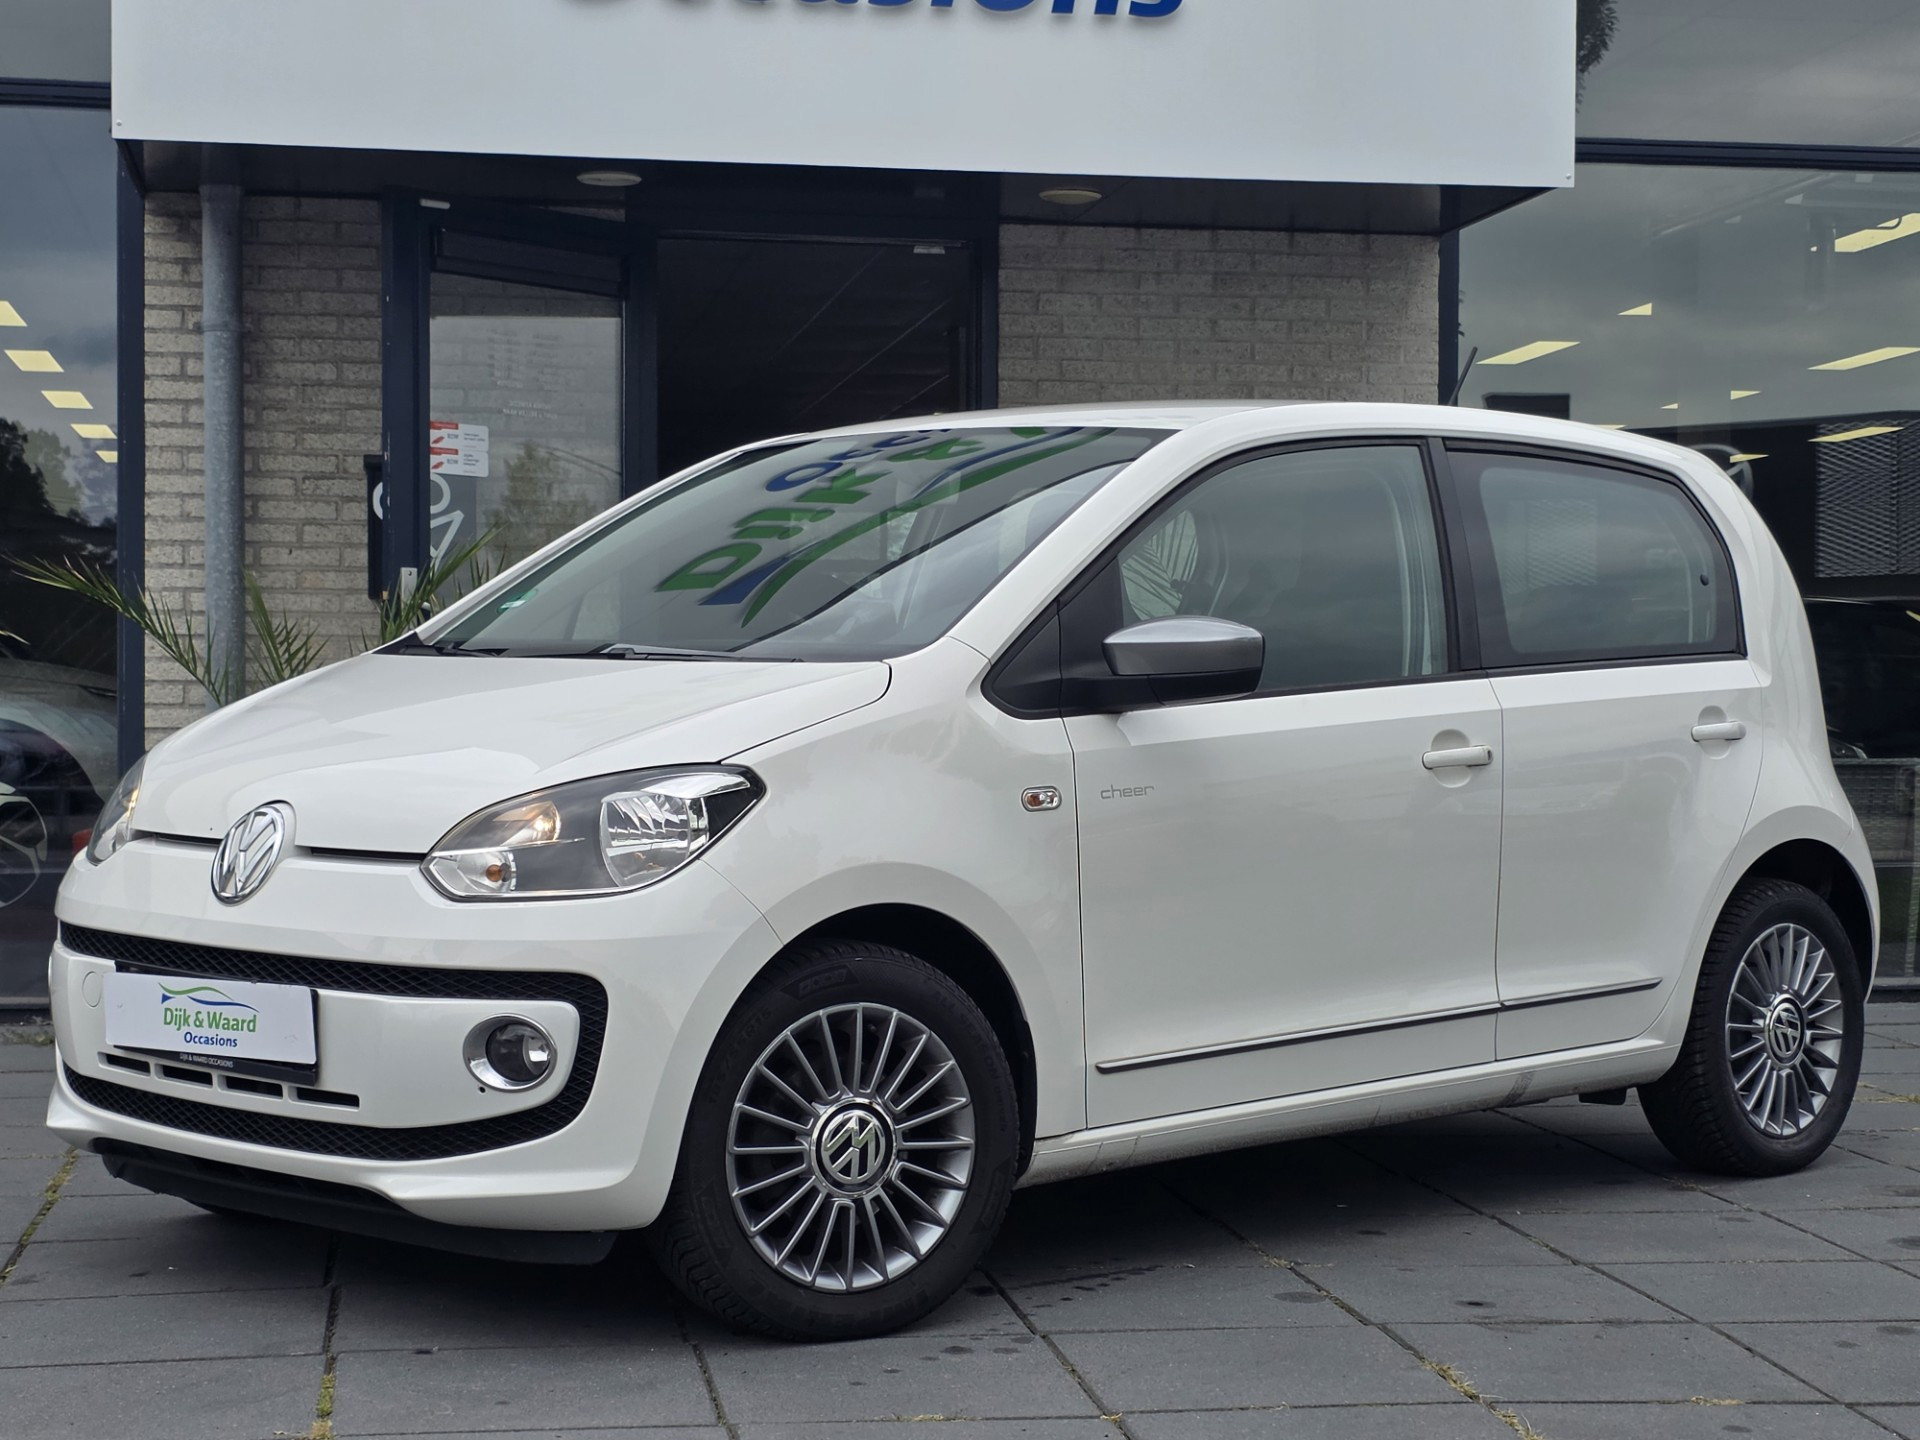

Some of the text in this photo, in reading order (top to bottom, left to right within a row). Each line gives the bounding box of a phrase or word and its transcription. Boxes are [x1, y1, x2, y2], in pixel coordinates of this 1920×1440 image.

[1100, 784, 1155, 800] cheer
[163, 1007, 257, 1032] Dijk & Waard
[184, 1031, 238, 1047] Occasions
